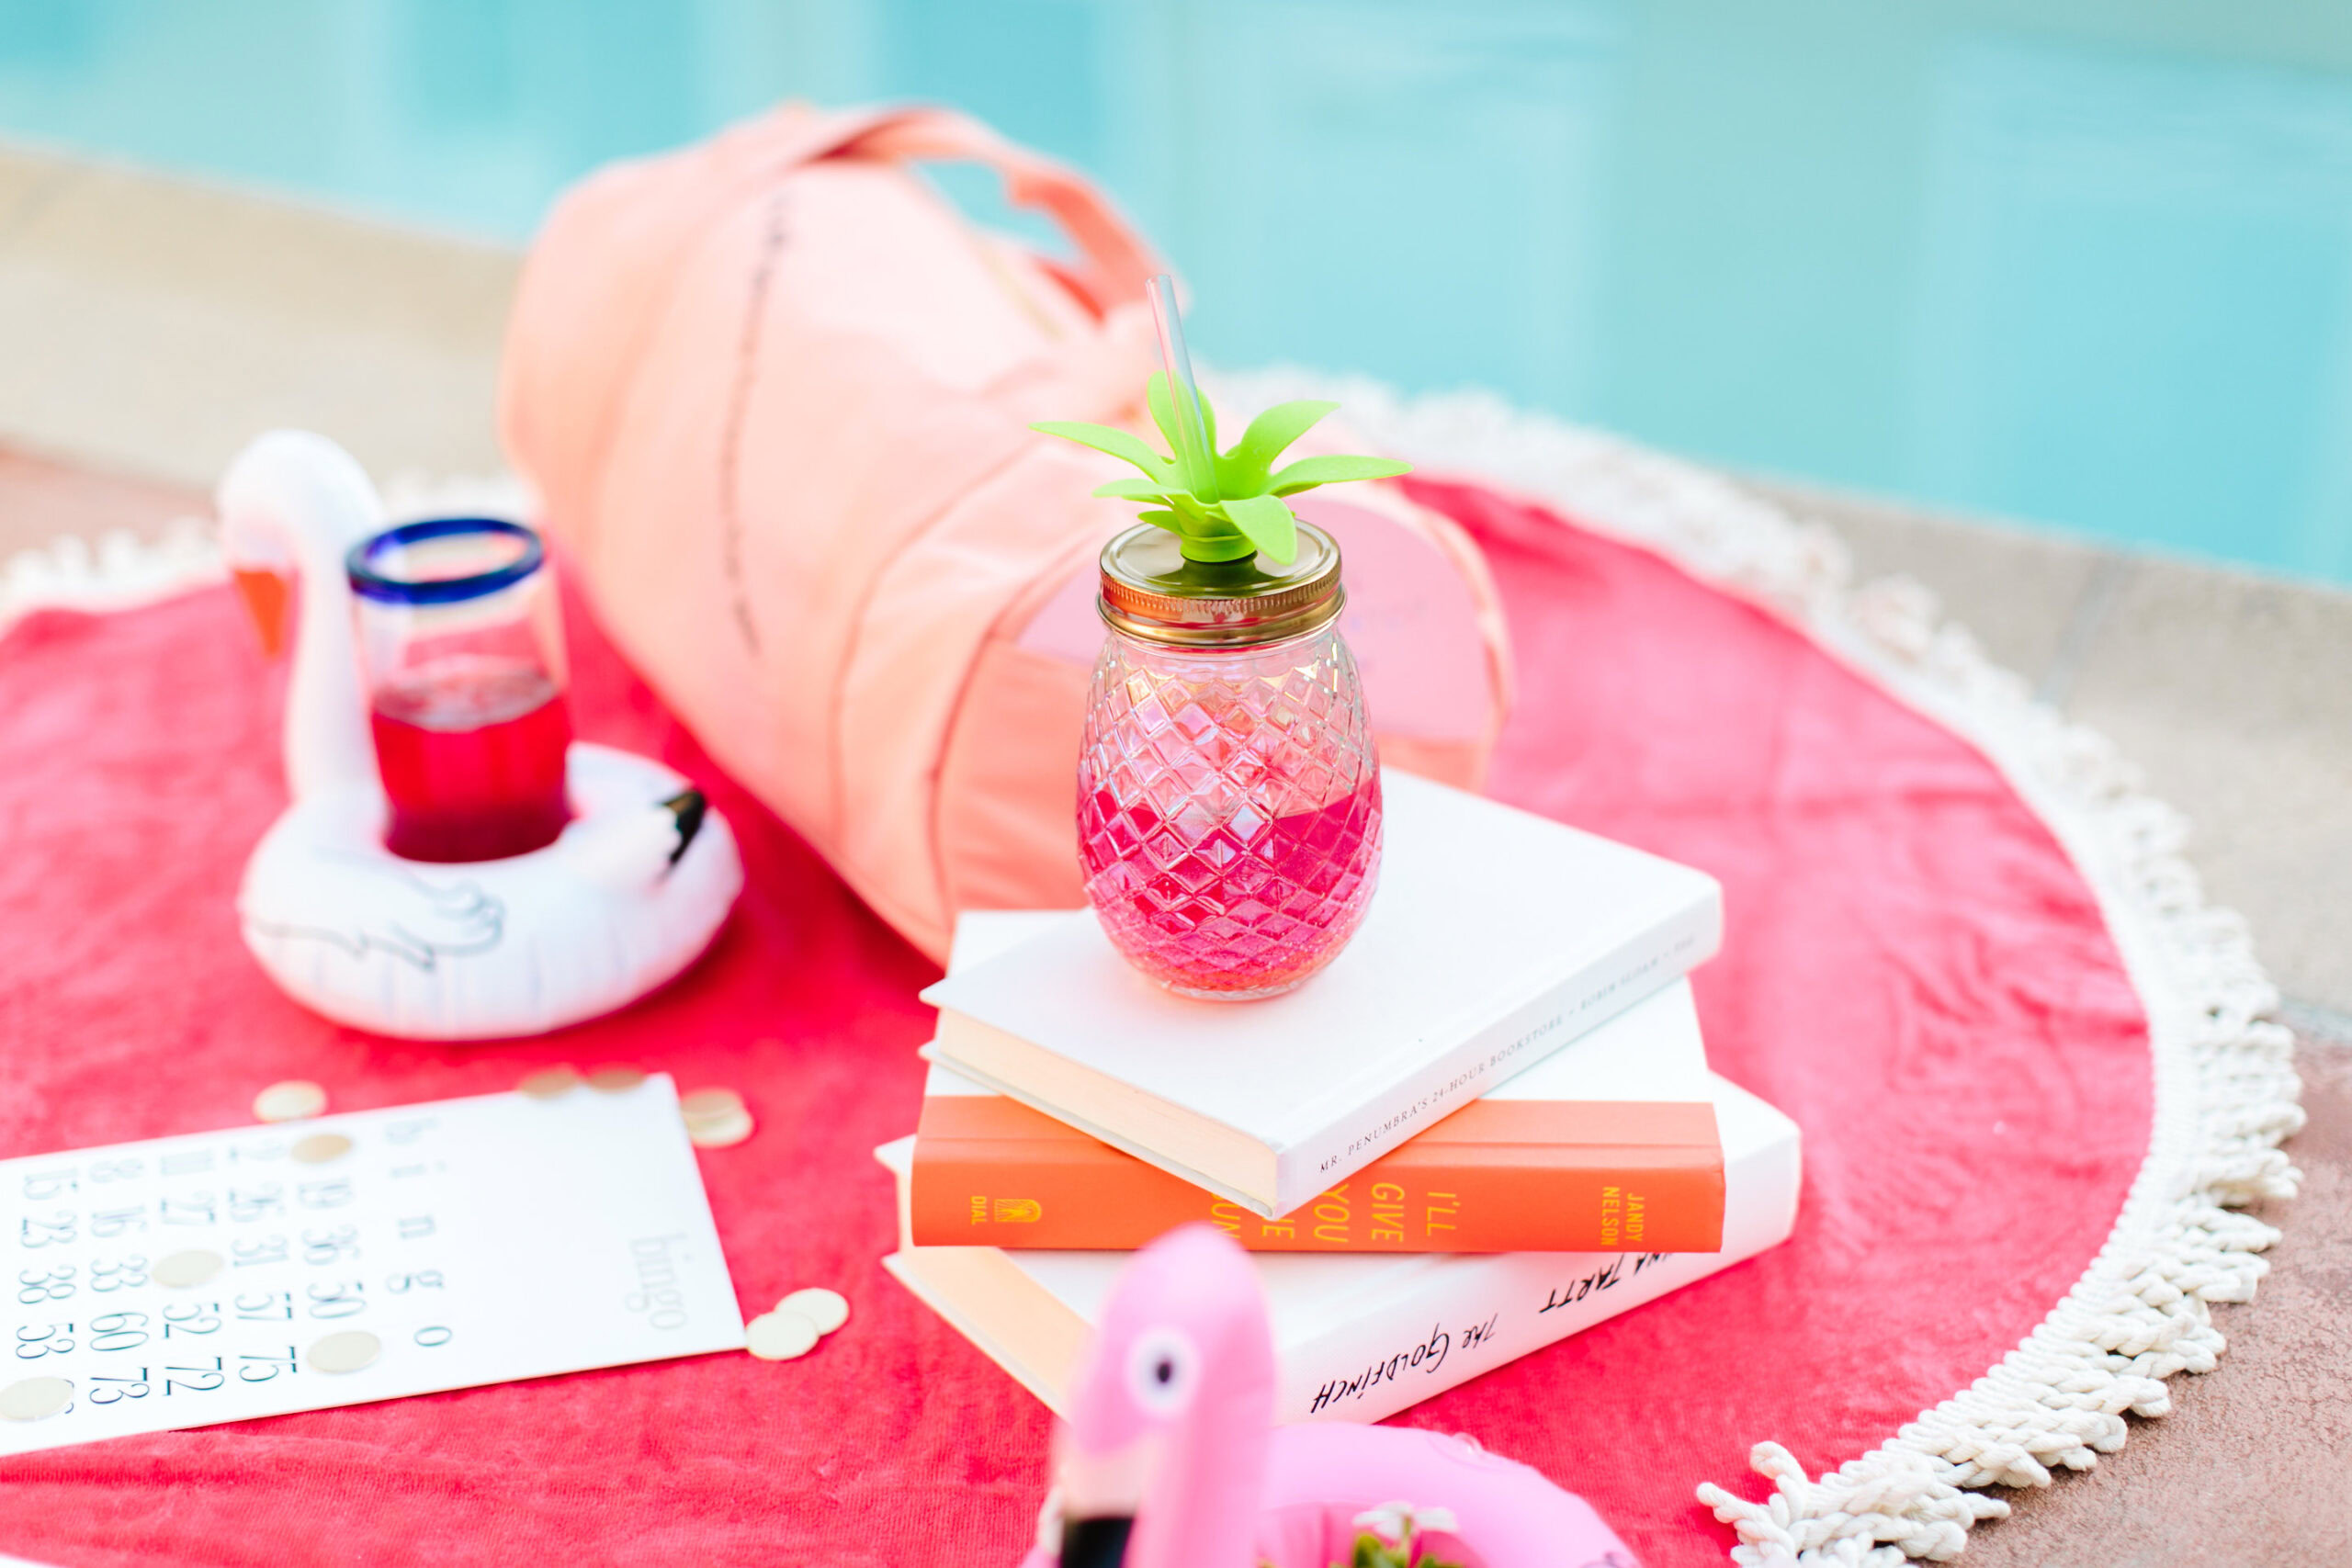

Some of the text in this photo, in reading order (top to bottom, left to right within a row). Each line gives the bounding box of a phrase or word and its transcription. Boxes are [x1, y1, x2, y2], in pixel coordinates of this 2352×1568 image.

[1319, 1155, 1342, 1173] MR.
[1348, 1099, 1428, 1156] PENUMBRA'S
[1432, 1063, 1485, 1102] 24-HOUR
[1489, 1014, 1562, 1067] BOOKSTORE
[90, 1204, 147, 1238] 16
[161, 1190, 216, 1225] 27
[970, 1195, 987, 1225] DIAL
[1210, 1193, 1241, 1239] UN
[1313, 1184, 1350, 1243] YOU
[1371, 1182, 1406, 1242] GIVE
[1427, 1191, 1461, 1236] I'LL
[1600, 1186, 1621, 1246] NELSON
[1625, 1192, 1645, 1242] JANDY
[16, 1167, 79, 1359] 15 23 38 53
[232, 1235, 288, 1267] 31
[301, 1224, 361, 1266] 36
[90, 1253, 148, 1292] 33
[627, 1231, 695, 1330] bingo
[1539, 1252, 1625, 1314] TARTT
[234, 1292, 292, 1320] 57
[306, 1280, 368, 1319] 50
[90, 1312, 149, 1352] 60
[162, 1303, 222, 1339] 52
[163, 1357, 225, 1396] 72
[239, 1346, 297, 1382] 75
[89, 1367, 150, 1404] 73
